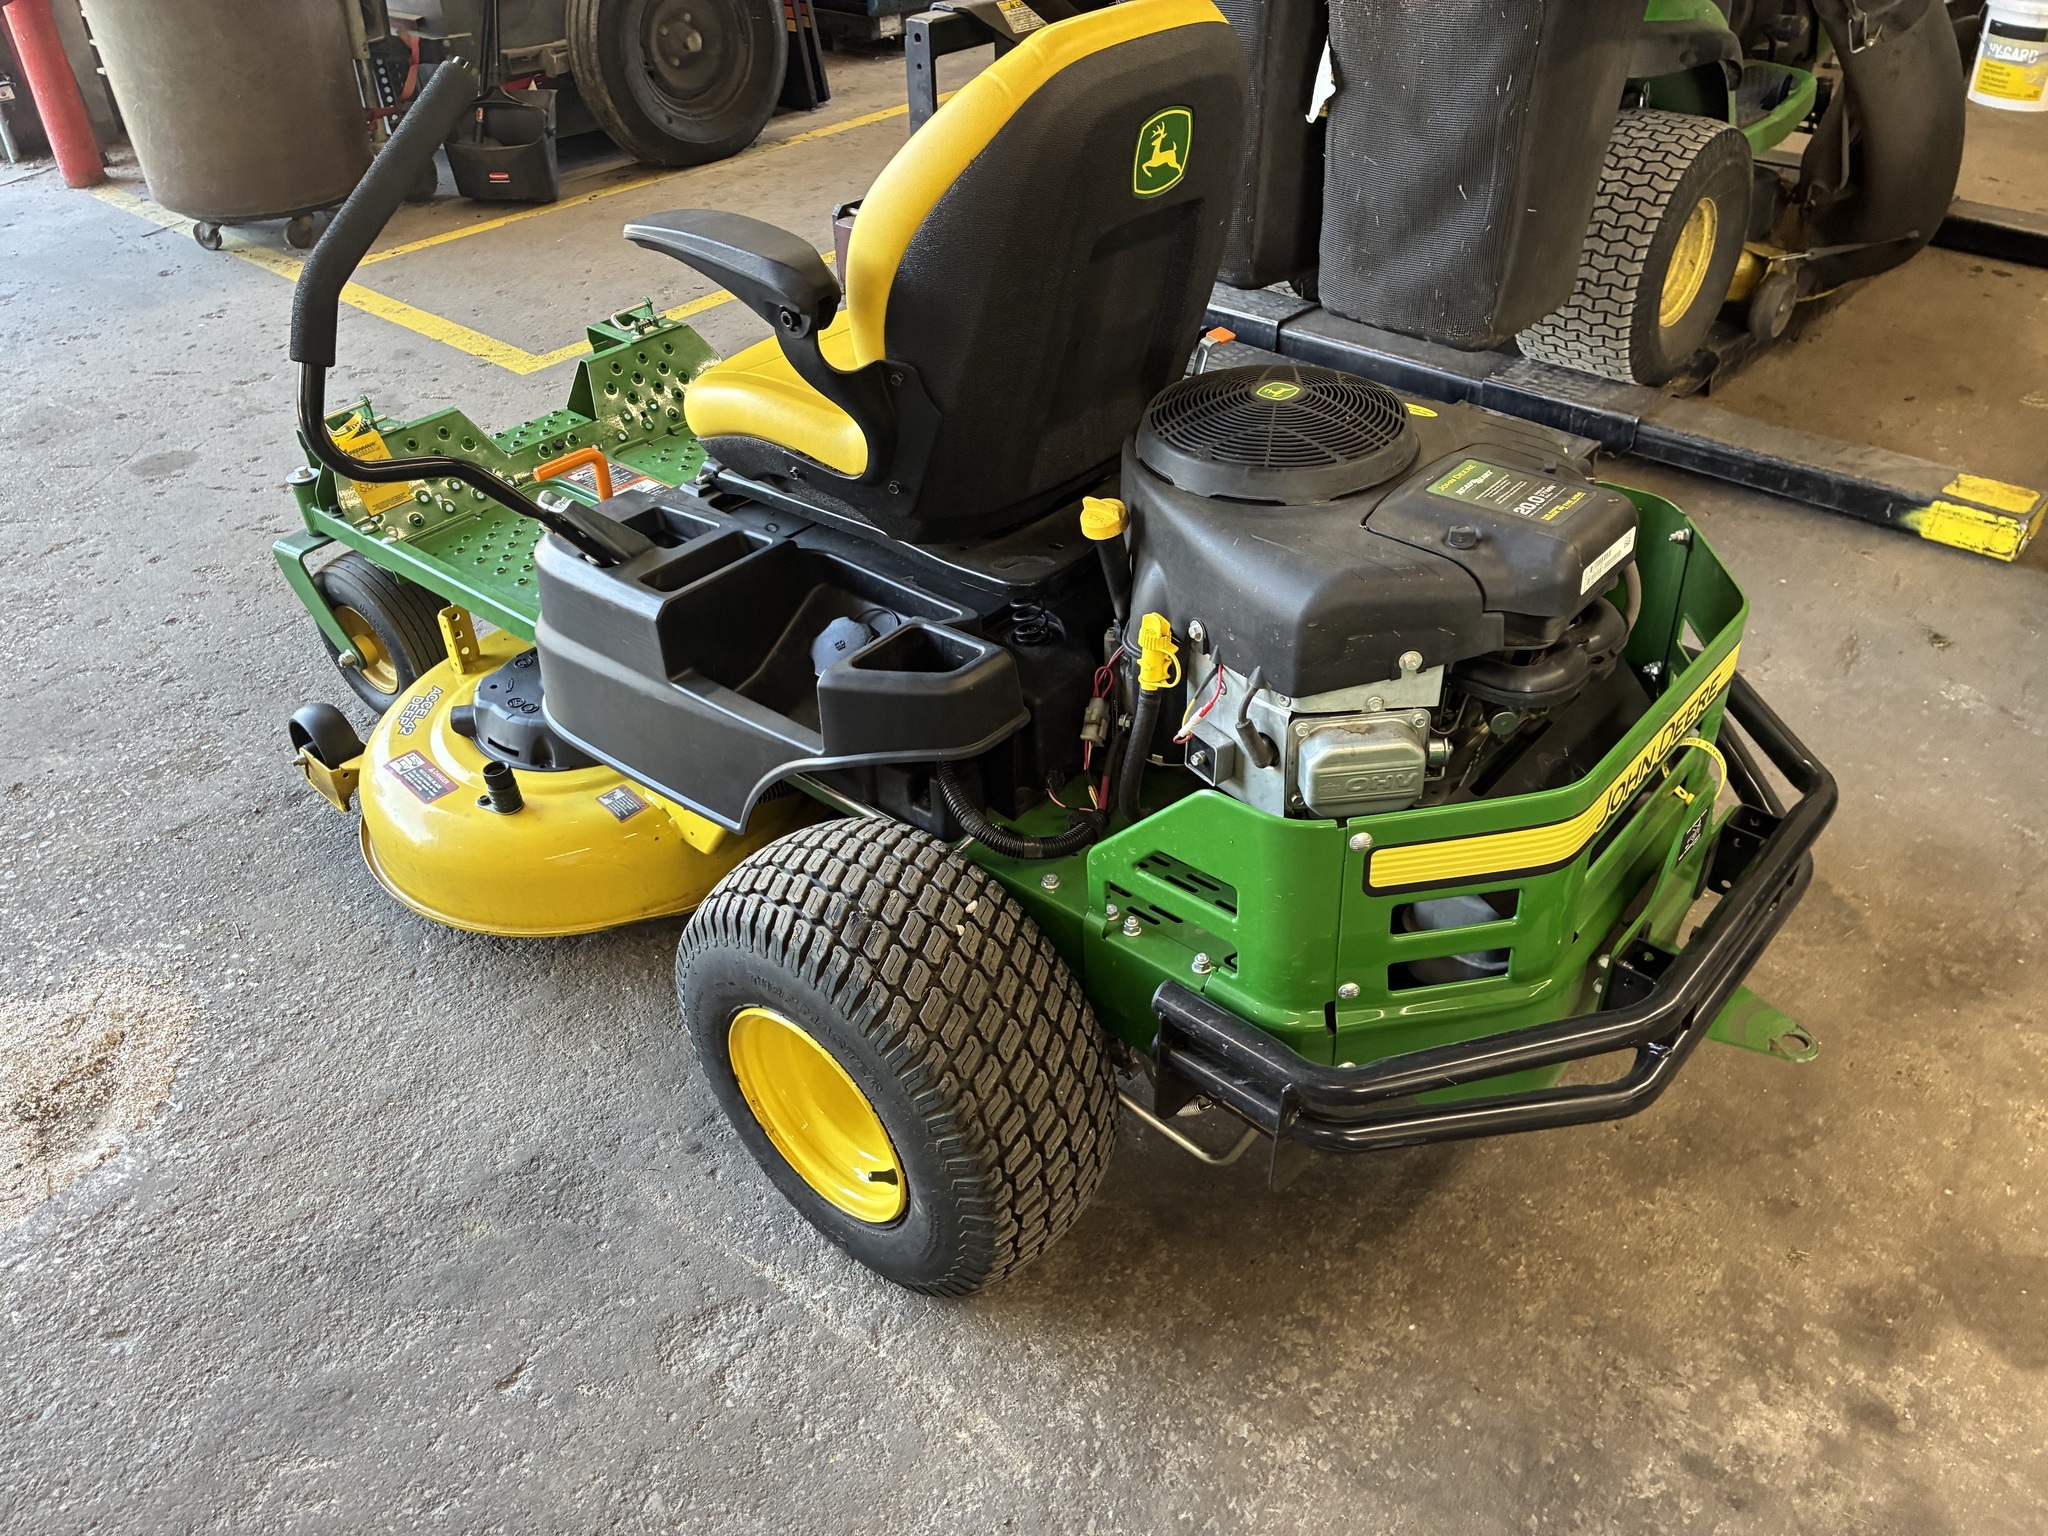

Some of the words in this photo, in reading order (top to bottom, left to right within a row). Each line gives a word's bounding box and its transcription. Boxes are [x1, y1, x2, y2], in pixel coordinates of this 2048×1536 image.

[1438, 477, 1458, 491] JOHN
[1453, 464, 1476, 480] DEERE
[1513, 495, 1545, 516] 20.0
[398, 696, 425, 725] DEEP
[1596, 747, 1656, 829] JOHN
[1657, 672, 1722, 761] DEERE
[432, 769, 450, 785] DANGER
[1345, 772, 1418, 792] OHV
